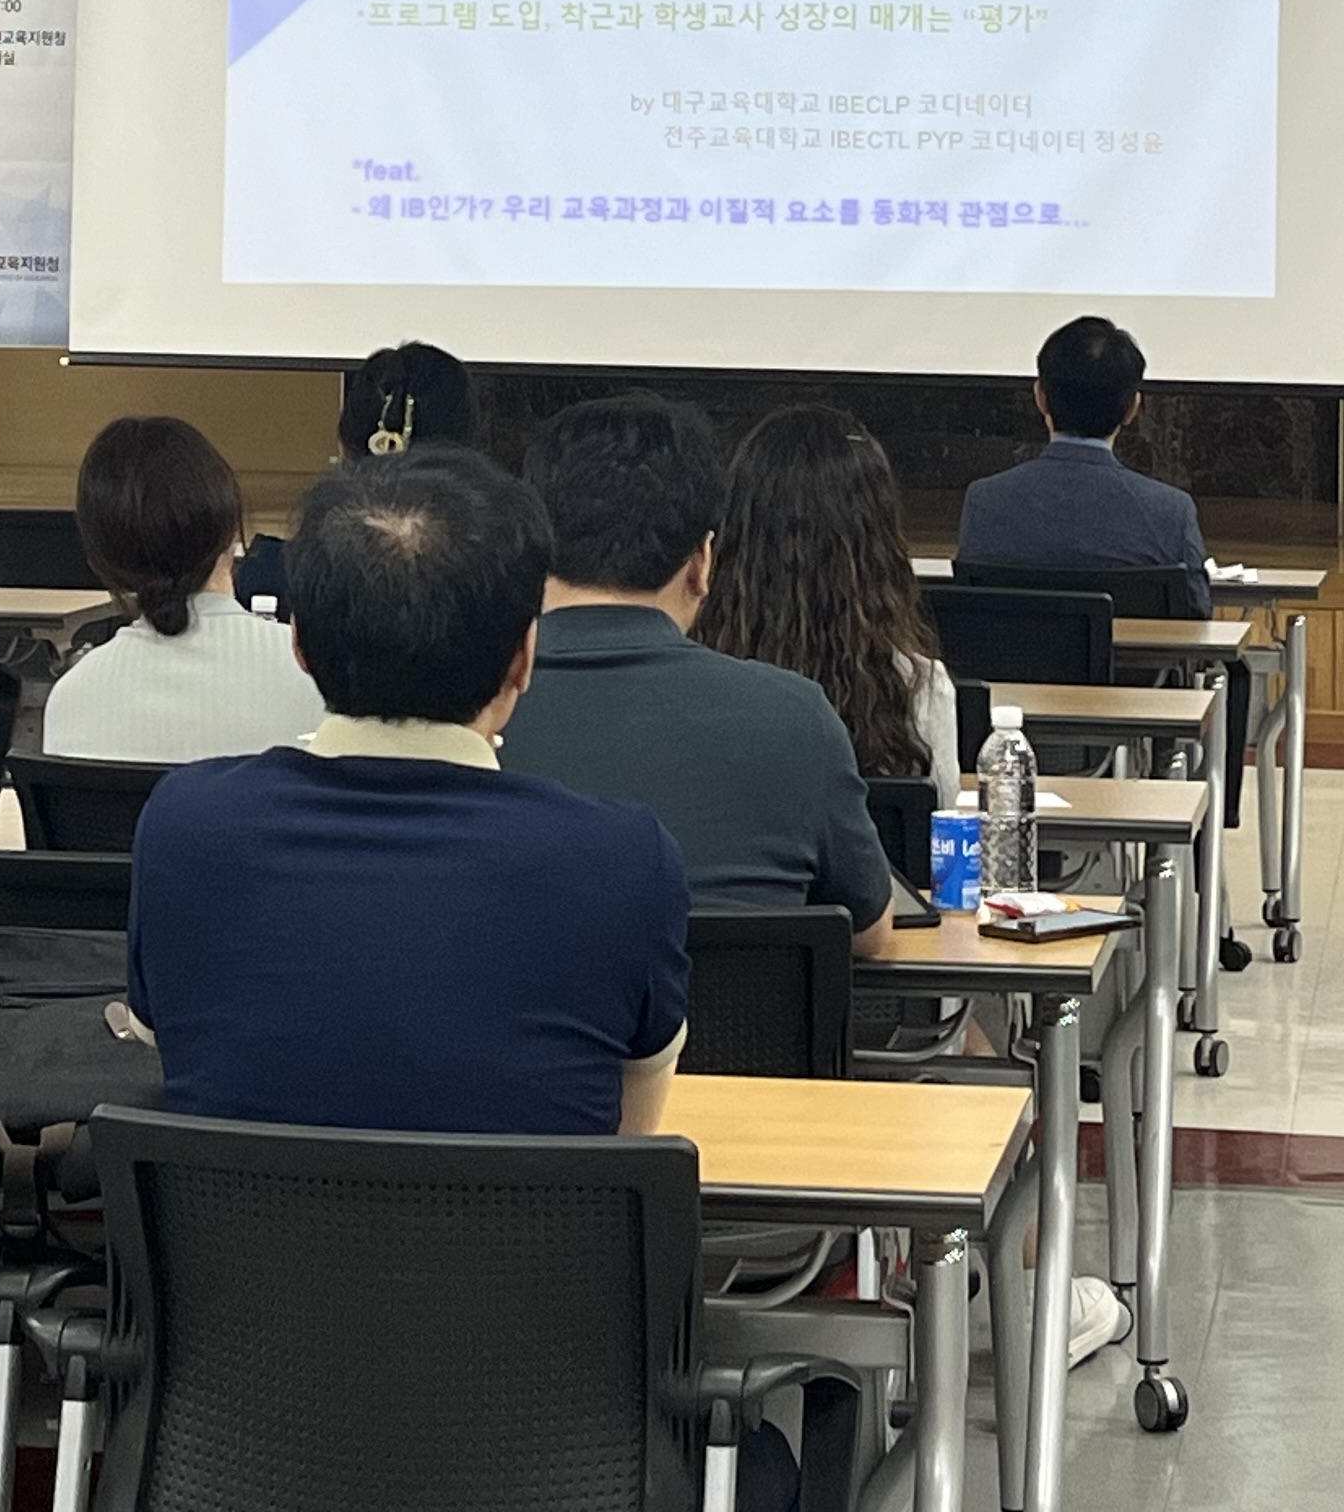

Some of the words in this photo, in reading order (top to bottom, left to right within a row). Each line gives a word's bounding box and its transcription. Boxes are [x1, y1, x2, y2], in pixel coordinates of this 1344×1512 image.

[368, 2, 478, 30] 프로그램
[489, 2, 552, 32] 도입,
[562, 2, 642, 30] 착근과
[654, 2, 765, 33] 학생교사
[775, 2, 857, 32] 성장의
[869, 3, 953, 33] 매개는
[630, 94, 655, 115] by
[662, 91, 821, 114] 대구교육대학교
[829, 96, 910, 115] IBECLP
[919, 93, 1032, 118] 코디네이터
[664, 126, 823, 150] 전주교육대학교
[831, 131, 910, 150] IBECTL
[918, 131, 963, 150] PYP
[971, 129, 1085, 152] 코디네이터
[368, 194, 391, 219] 왜
[401, 195, 494, 220] IB인가?
[502, 195, 550, 221] 우리
[562, 196, 690, 223] 교육과정과
[700, 198, 775, 224] 이질적
[786, 198, 858, 224] 요소를
[872, 200, 950, 227] 동화적
